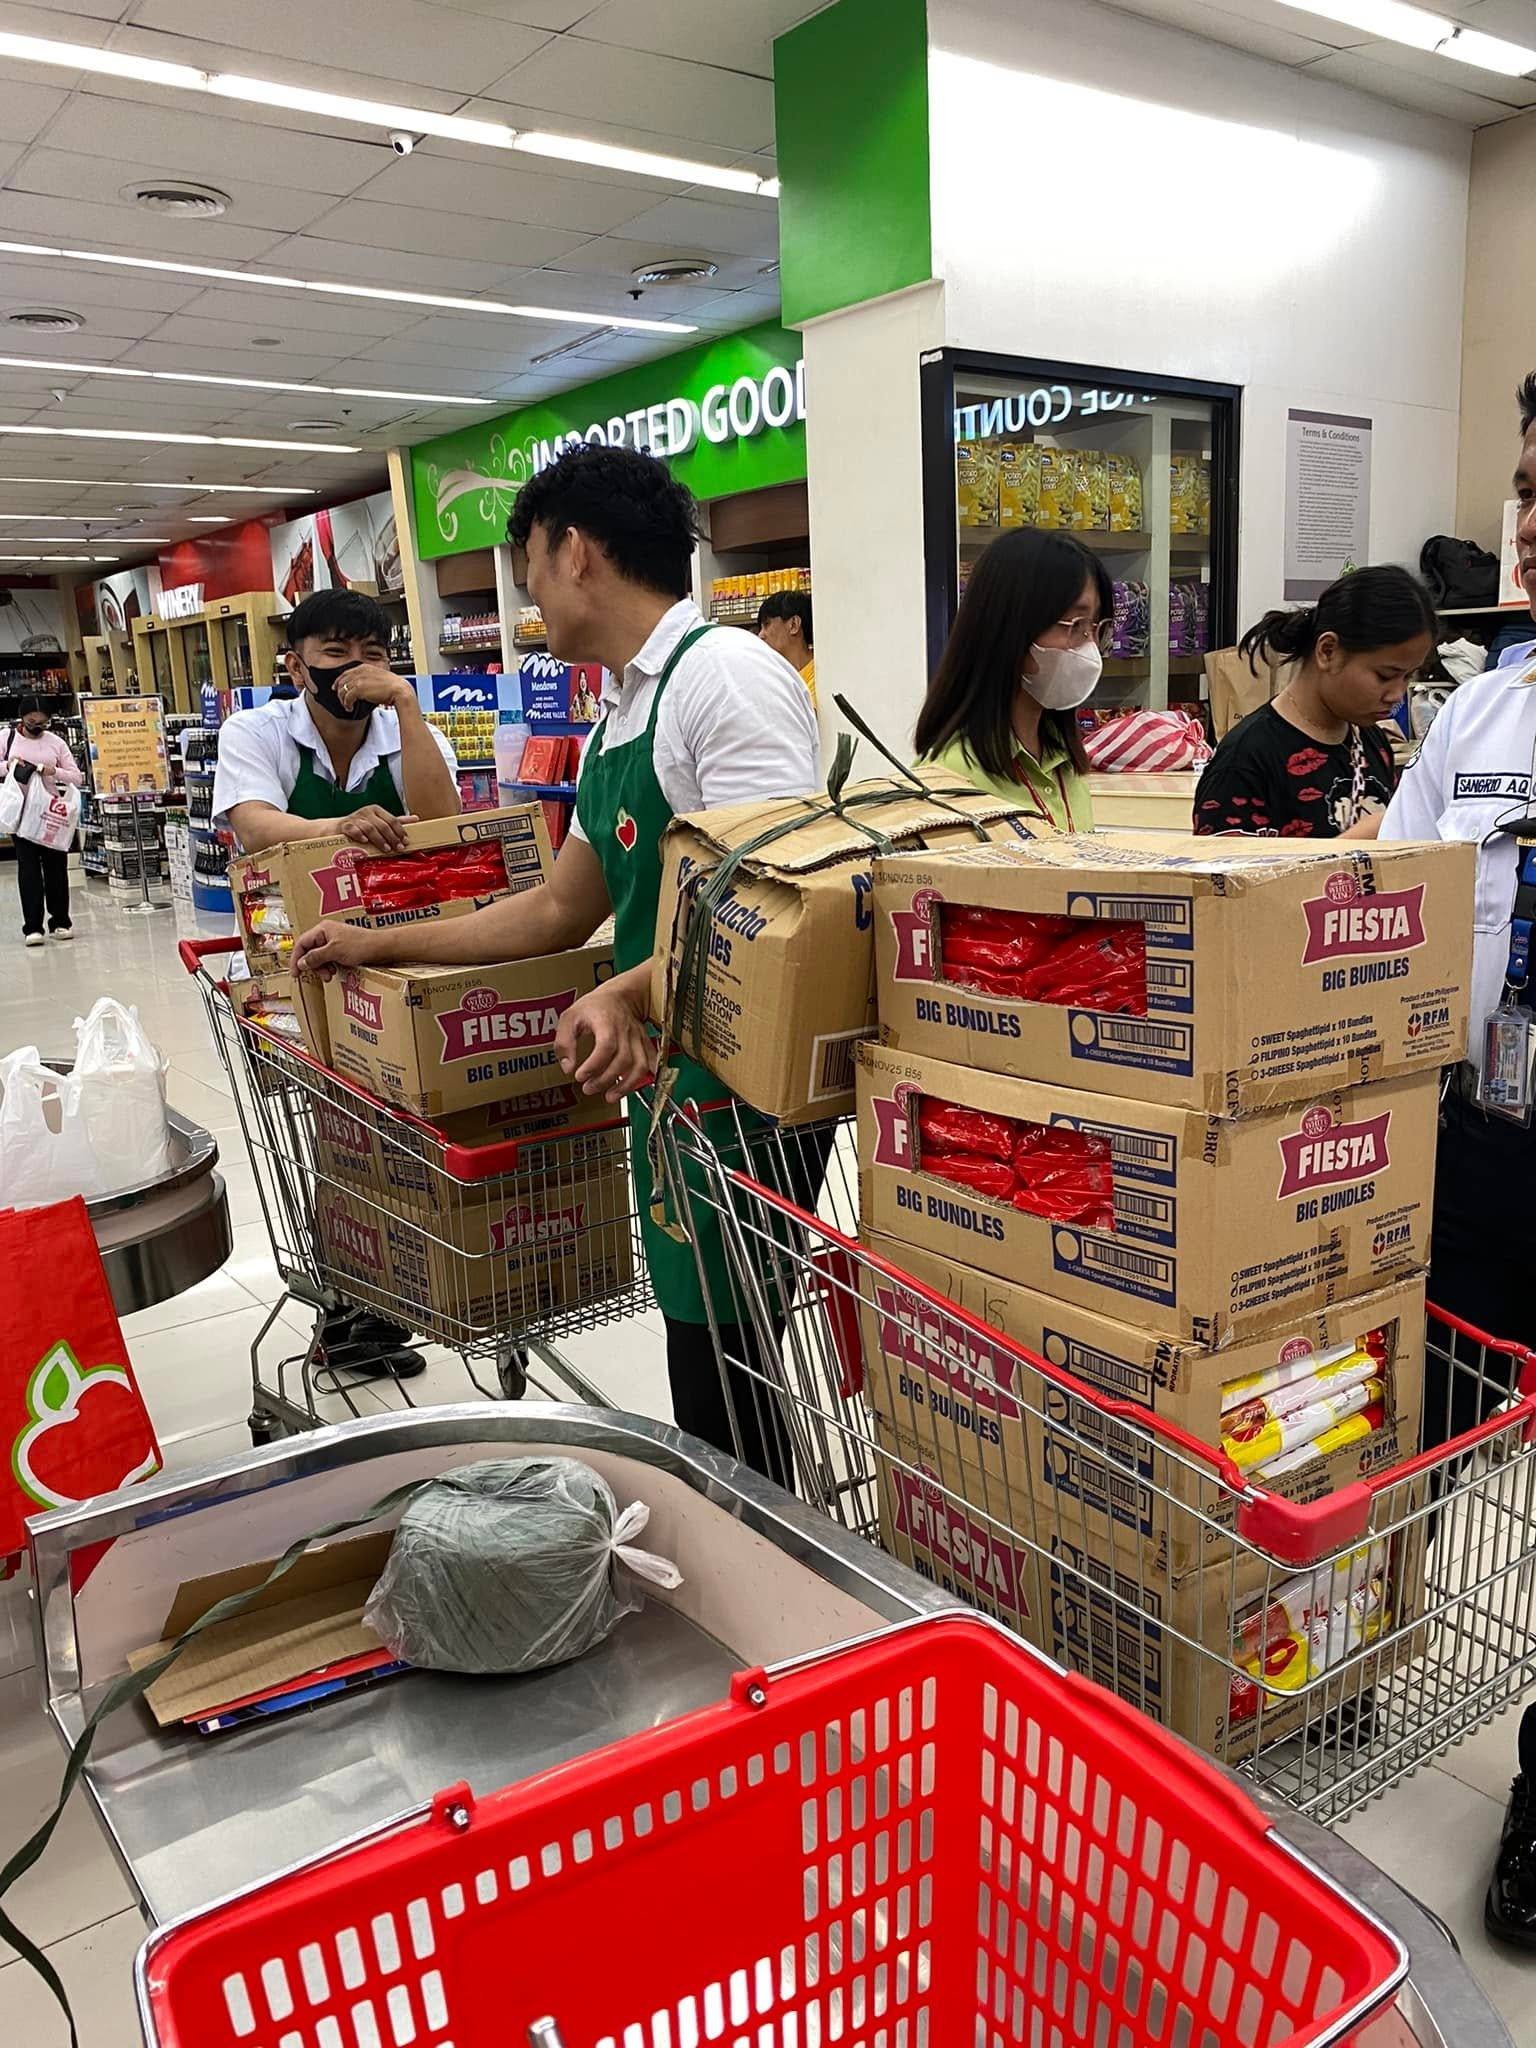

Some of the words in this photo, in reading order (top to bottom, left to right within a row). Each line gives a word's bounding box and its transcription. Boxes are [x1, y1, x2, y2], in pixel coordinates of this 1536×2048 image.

[1302, 427, 1321, 439] Terms
[1322, 429, 1327, 439] &
[1329, 430, 1360, 442] Conditions
[157, 583, 200, 621] WINERY
[531, 681, 558, 691] Meadows
[450, 704, 485, 712] Meadows
[102, 721, 116, 729] No
[117, 720, 146, 728] Brand
[376, 904, 441, 928] BUNDLES
[1323, 906, 1410, 946] FIESTA
[1322, 968, 1346, 992] BIG
[1349, 957, 1410, 987] BUNDLES
[347, 990, 377, 1023] FIESTA
[710, 988, 742, 1016] FOODS
[915, 998, 942, 1024] BIG
[945, 1003, 1022, 1038] BUNDLES
[1423, 1007, 1449, 1026] RFM
[462, 1008, 559, 1047] FIESTA
[1260, 1032, 1285, 1047] SWEET
[1286, 1023, 1330, 1042] Spaghettipid
[1338, 1020, 1346, 1030] 10
[1347, 1015, 1374, 1028] Bundles
[1260, 1047, 1290, 1062] FILIPINO
[1291, 1038, 1335, 1057] Spaghettipid
[1342, 1035, 1350, 1045] 10
[1351, 1029, 1377, 1042] Bundles
[467, 1064, 493, 1084] BIG
[498, 1050, 558, 1077] BUNDLE
[1260, 1063, 1295, 1079] 3-CHEESE
[1296, 1053, 1340, 1072] Spaghettipid
[500, 1087, 566, 1115] FIESTA
[324, 1111, 363, 1148] FIESTA
[503, 1126, 522, 1138] BIG
[524, 1114, 569, 1134] BUNDLES
[1298, 1133, 1376, 1180] FIESTA
[896, 1184, 922, 1213] BIG
[927, 1195, 1005, 1241] BUNDLES
[1296, 1199, 1318, 1223] BIG
[1321, 1181, 1375, 1215] BUNDLES
[333, 1218, 375, 1260] FIESTA
[505, 1216, 573, 1246] FIESTA
[1387, 1223, 1410, 1244] RFM
[1239, 1264, 1262, 1280] SWEET
[1263, 1252, 1303, 1273] Spaghettipid
[1238, 1291, 1271, 1311] 3-CHEESE
[1239, 1278, 1266, 1295] FILIPINO
[898, 1310, 997, 1397] FIESTA
[899, 1374, 924, 1405] BIG
[929, 1389, 1000, 1445] BUNDLES
[1374, 1437, 1399, 1457] RFM
[911, 1498, 1010, 1594] FIESTA
